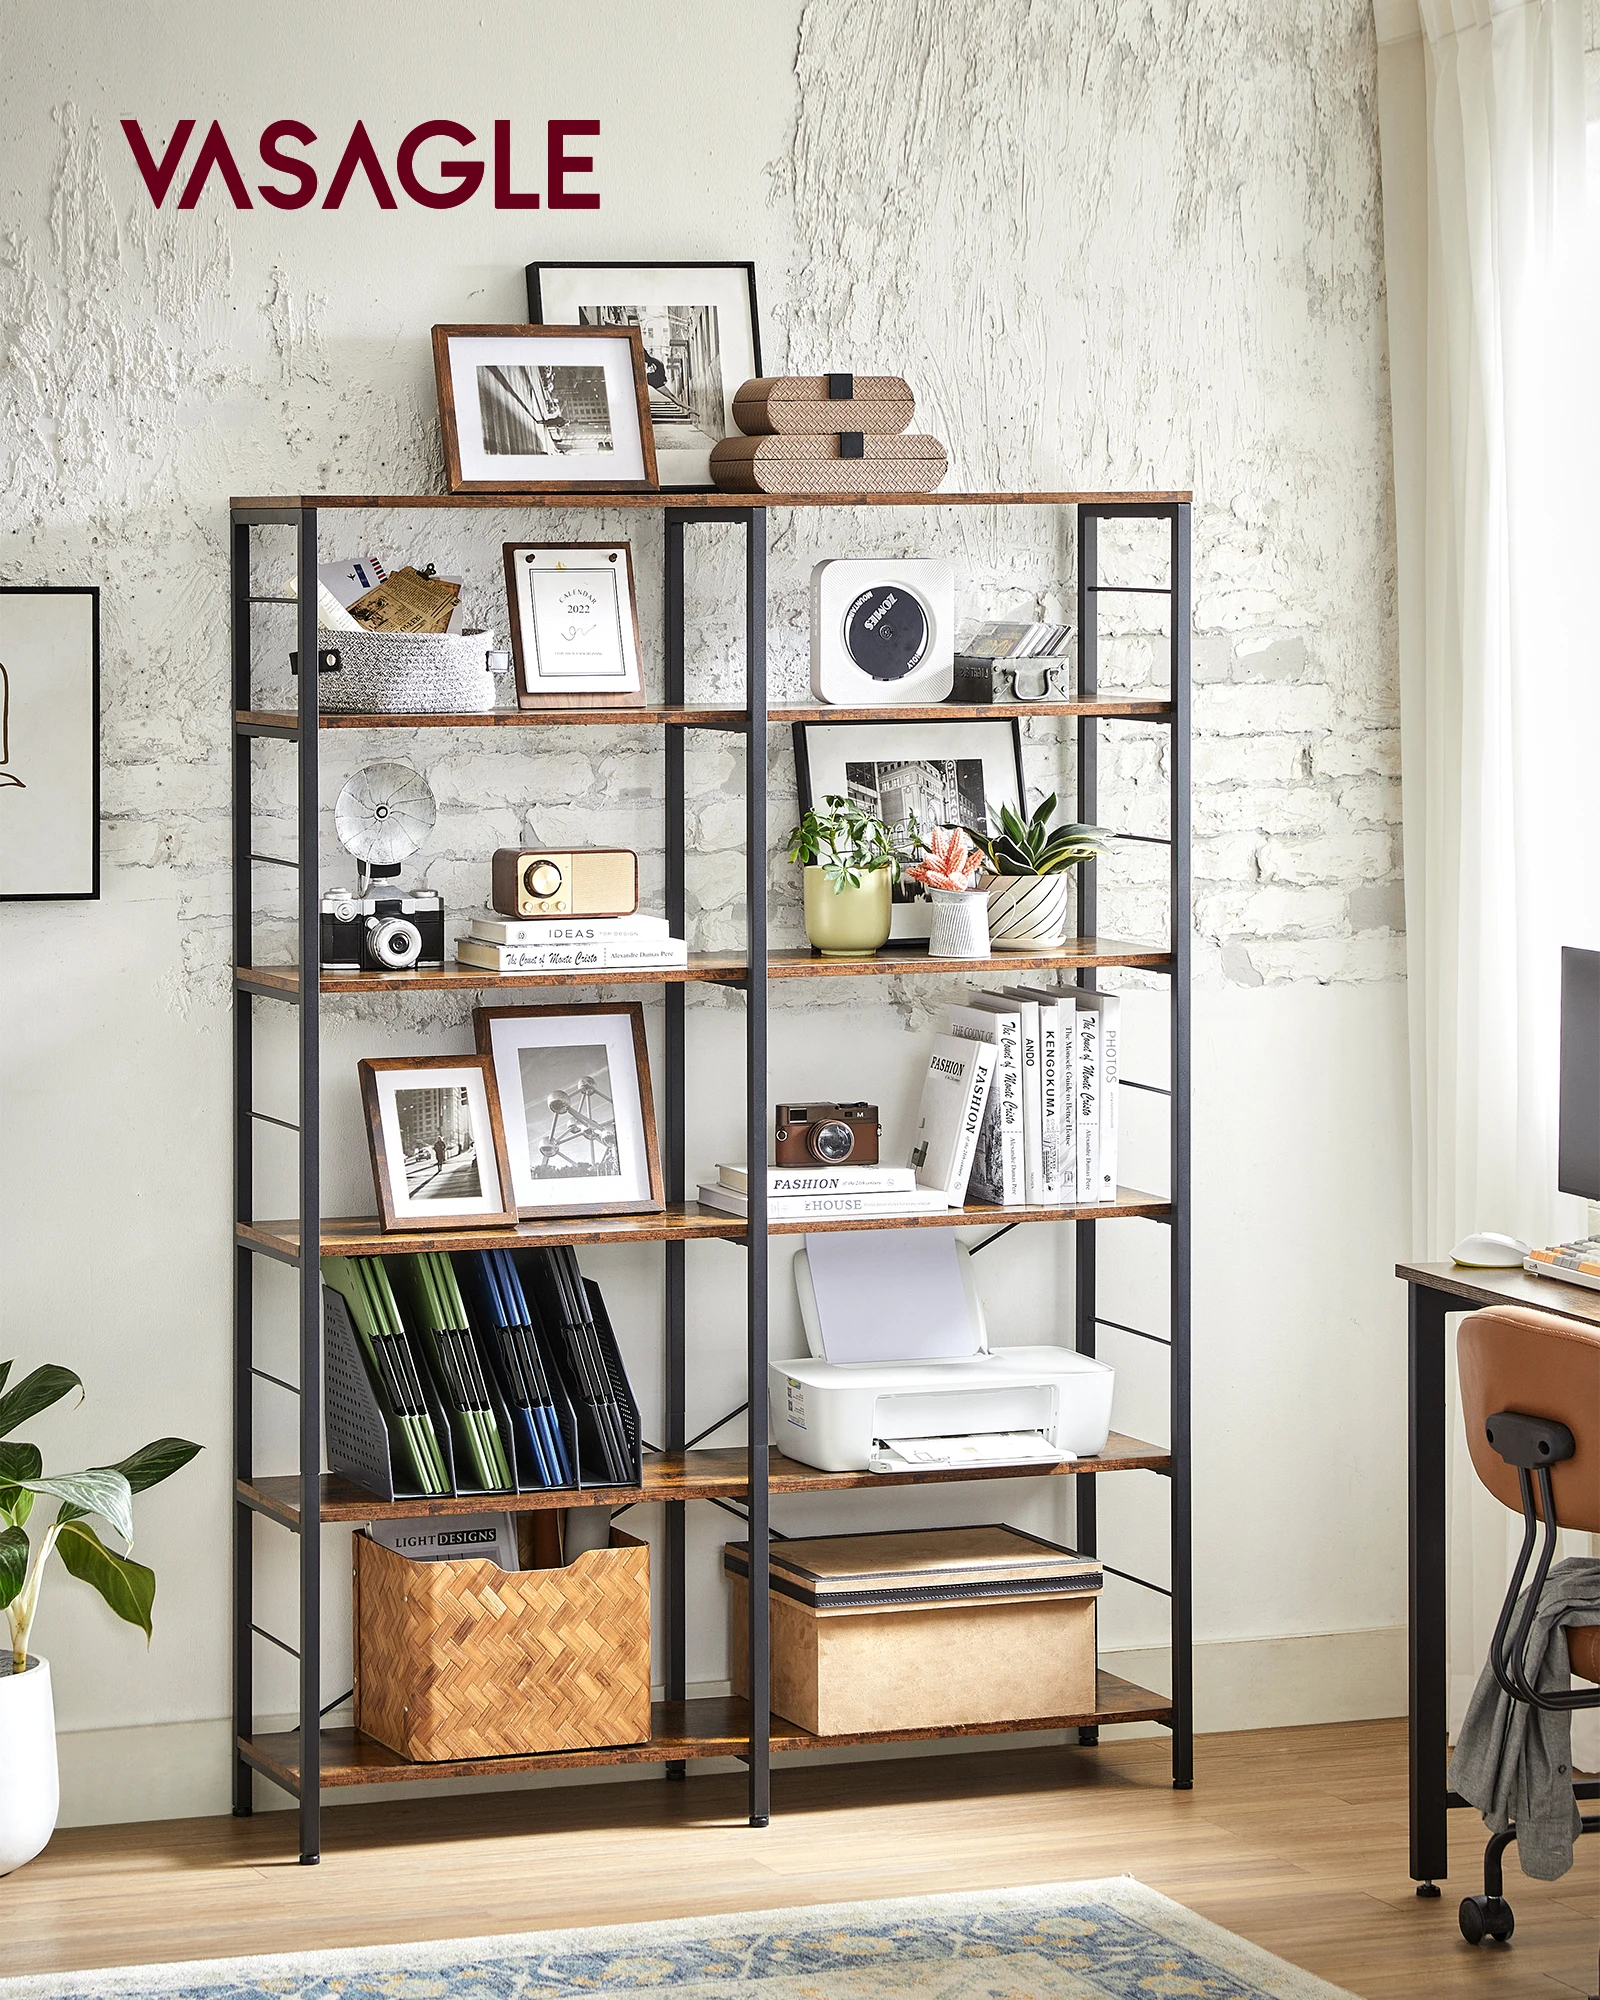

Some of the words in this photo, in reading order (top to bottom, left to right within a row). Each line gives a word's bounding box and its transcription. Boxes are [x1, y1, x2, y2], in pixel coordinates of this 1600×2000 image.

[558, 588, 597, 605] CALENDAR
[567, 604, 590, 614] 2022
[549, 929, 595, 939] IDEAS
[506, 953, 517, 965] The
[518, 952, 538, 967] Count
[538, 953, 546, 968] of
[548, 952, 572, 964] Monte
[574, 951, 598, 966] Cristo
[952, 1024, 964, 1036] THE
[964, 1026, 985, 1041] COUNT
[985, 1031, 994, 1042] OF
[1002, 1021, 1016, 1035] The
[1082, 1017, 1095, 1030] The
[1000, 1038, 1017, 1059] Count
[1080, 1031, 1095, 1053] Count
[1025, 1038, 1035, 1066] ANDO
[1079, 1053, 1094, 1061] of
[1105, 1030, 1117, 1083] PHOTOS
[930, 1056, 965, 1077] FASHION
[999, 1061, 1016, 1069] of
[1045, 1030, 1055, 1117] KENGOKUMA
[1004, 1072, 1017, 1098] Monte
[1082, 1064, 1095, 1090] Monte
[965, 1065, 988, 1134] FASHION
[1080, 1092, 1095, 1116] Cristo
[1002, 1100, 1018, 1124] Cristo
[773, 1178, 840, 1190] FASHION
[812, 1200, 863, 1211] HOUSE
[395, 1534, 436, 1548] LIGHT
[439, 1529, 495, 1545] DESIGNS
